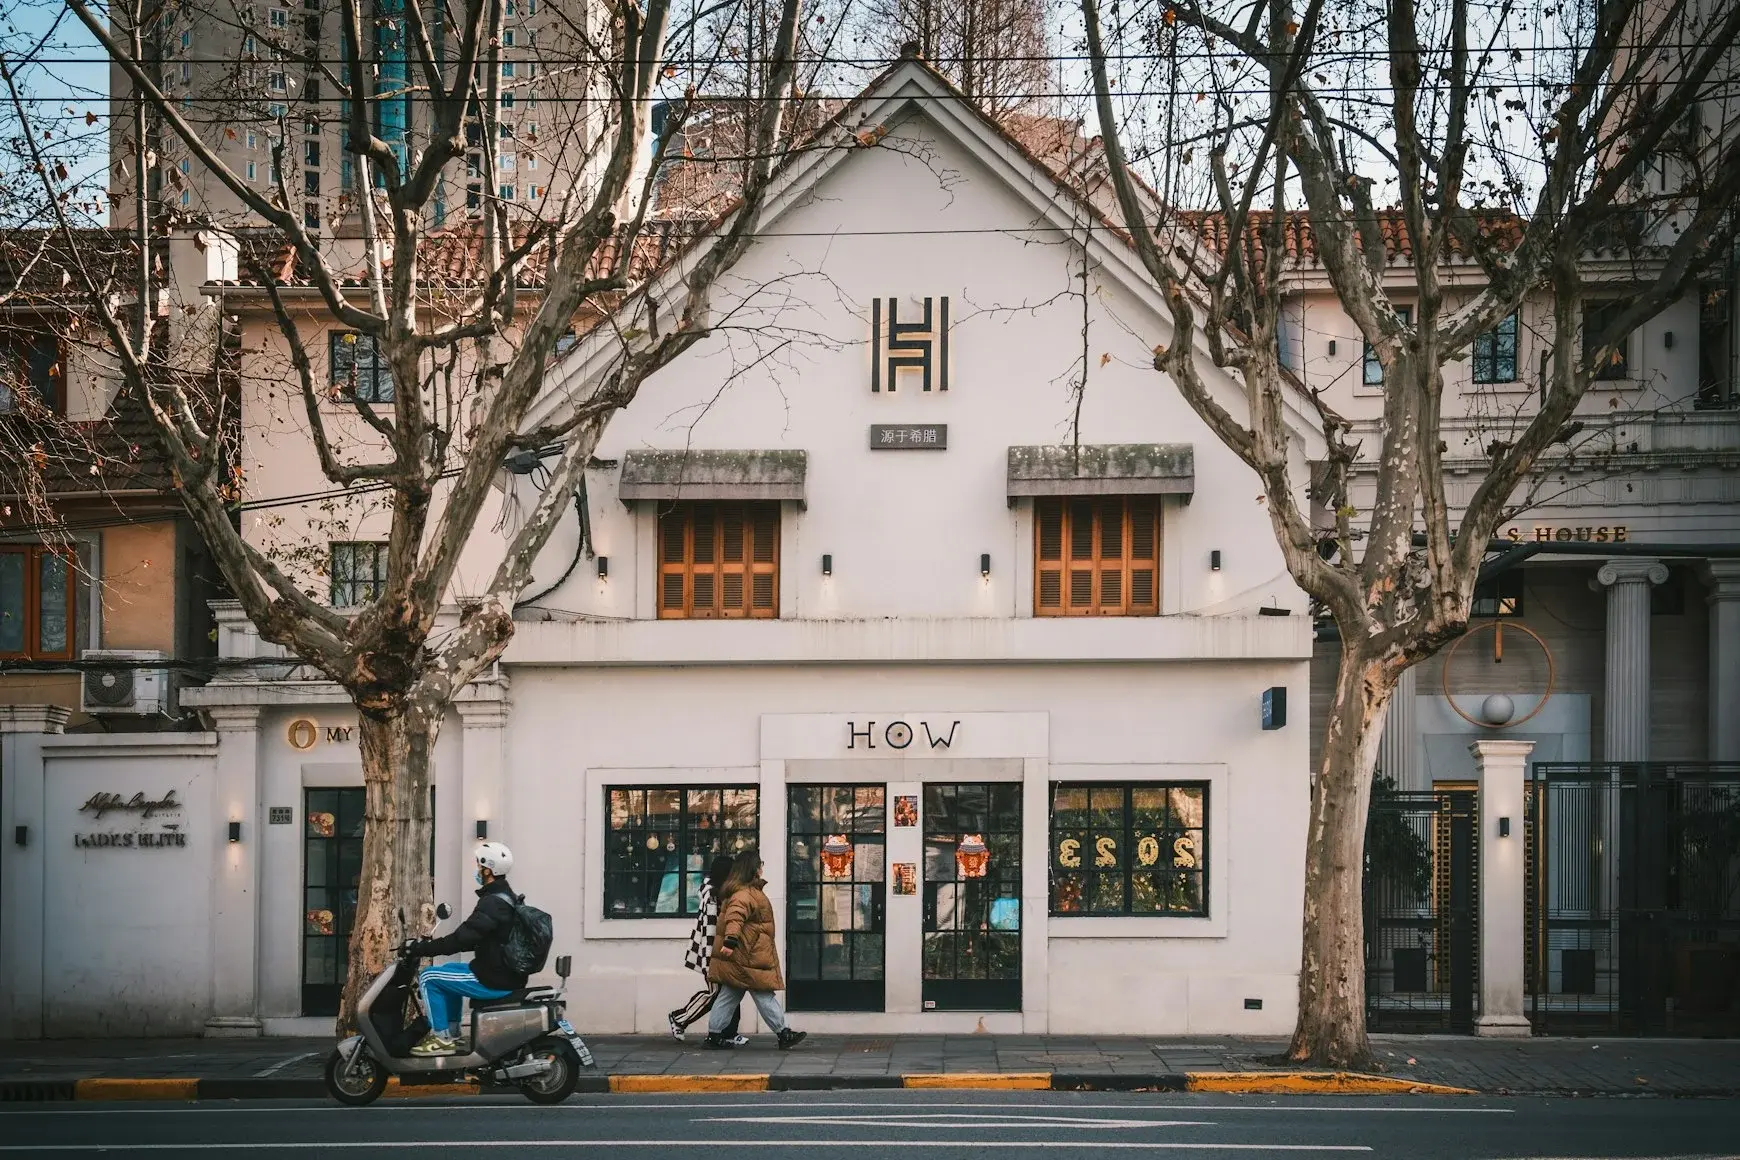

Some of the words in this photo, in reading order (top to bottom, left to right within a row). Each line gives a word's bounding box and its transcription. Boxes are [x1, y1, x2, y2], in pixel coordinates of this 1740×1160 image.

[880, 429, 937, 444] 源于希腊
[1535, 526, 1627, 542] HOUSE
[326, 726, 353, 742] MY
[847, 720, 960, 749] HOW
